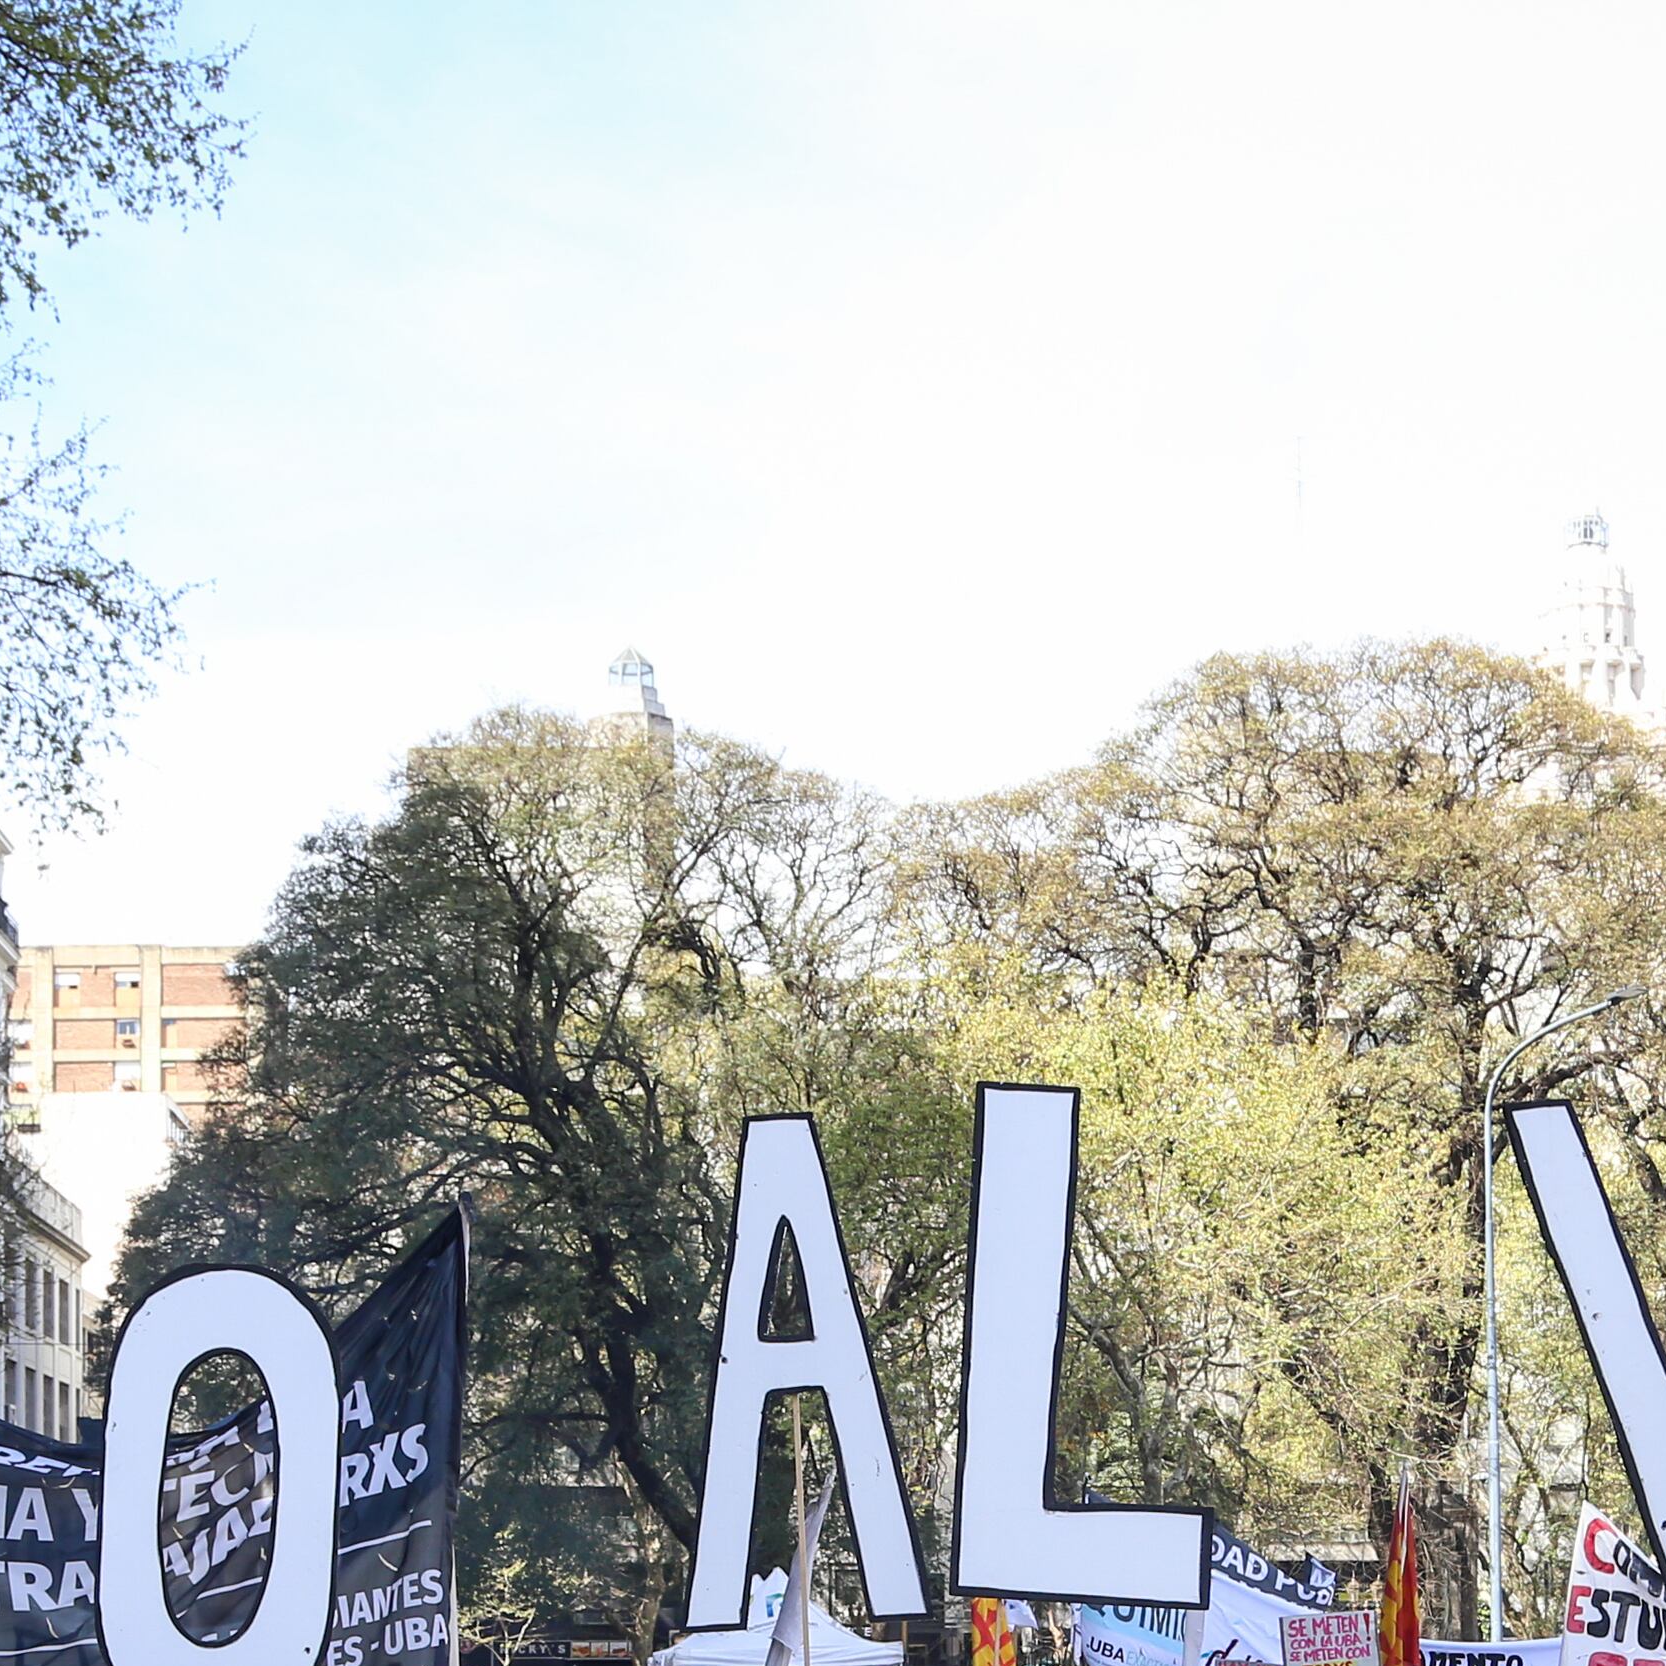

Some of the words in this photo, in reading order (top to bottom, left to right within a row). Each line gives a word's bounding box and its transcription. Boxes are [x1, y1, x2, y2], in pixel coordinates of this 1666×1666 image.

[686, 1081, 1214, 1631] AL
[384, 1612, 449, 1656] UBA
[1288, 1618, 1307, 1637] SE
[1311, 1614, 1359, 1636] METEN
[1289, 1651, 1302, 1661] SE
[1304, 1647, 1343, 1662] METEN
[1345, 1644, 1371, 1660] CON
[1290, 1637, 1316, 1650] CON
[1321, 1635, 1332, 1647] LA
[1335, 1633, 1362, 1647] UBA
